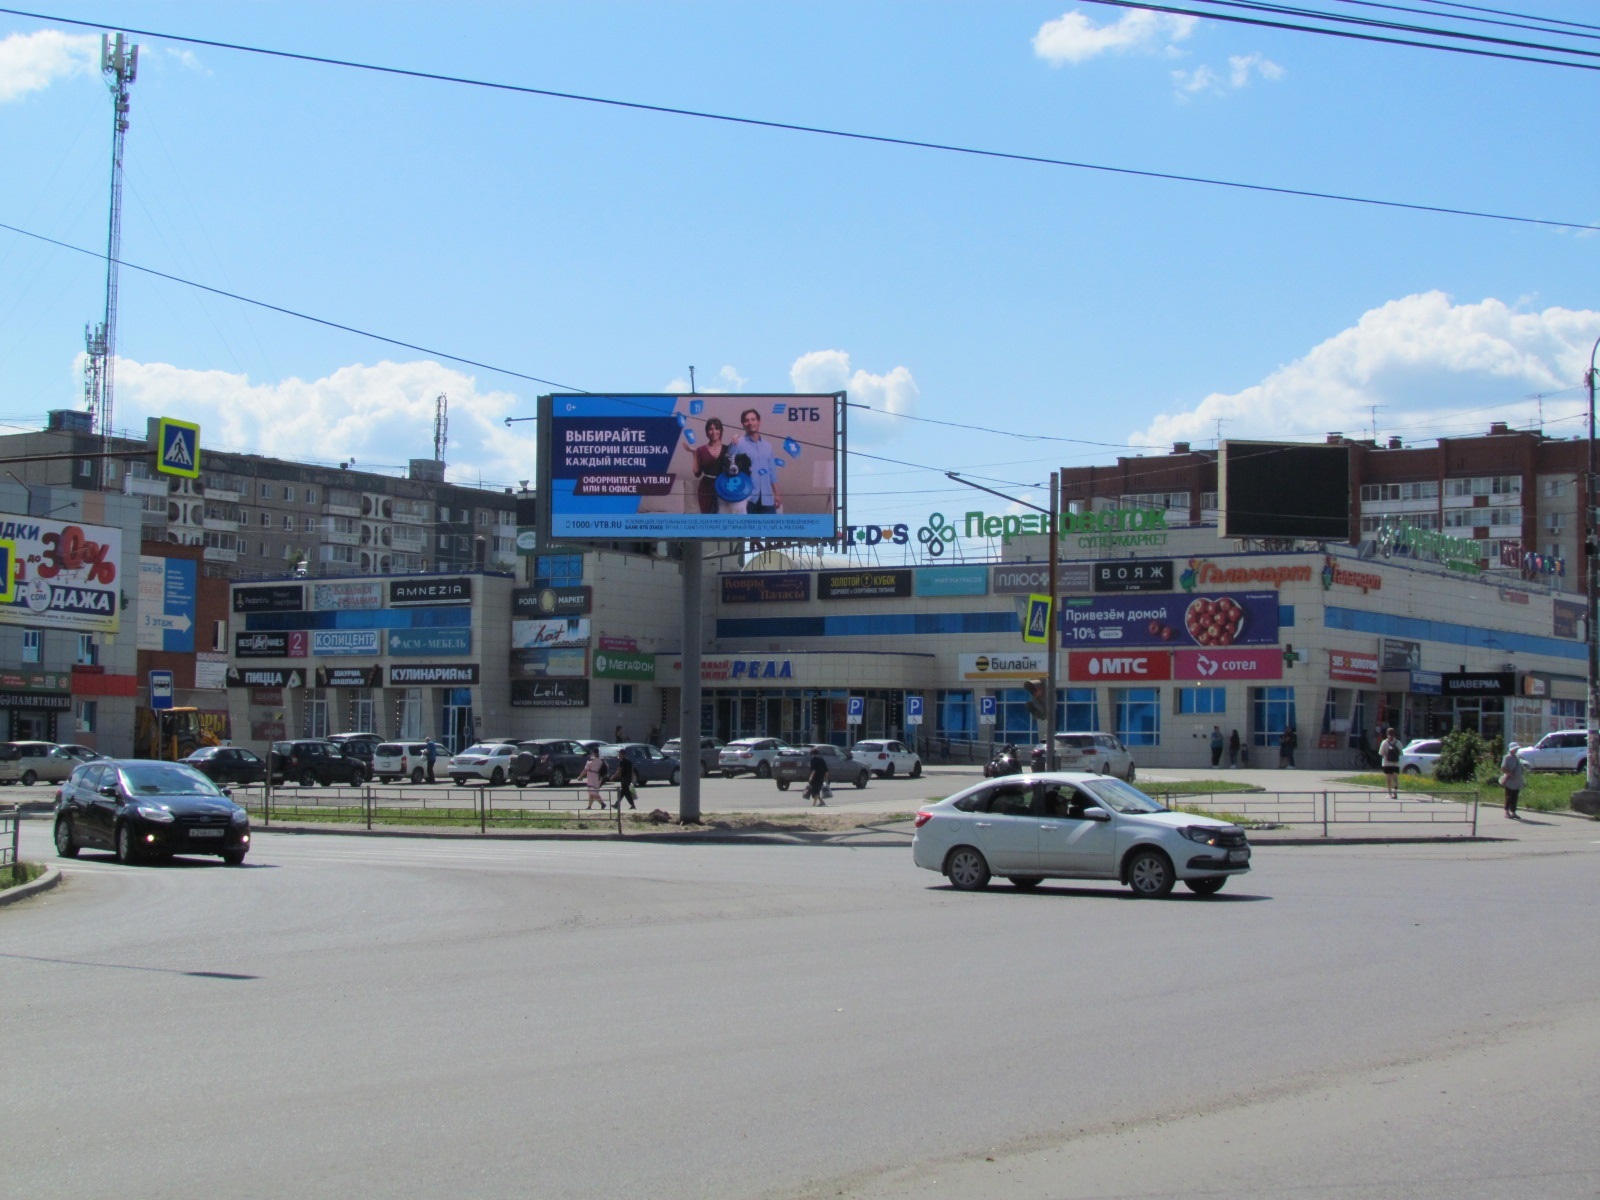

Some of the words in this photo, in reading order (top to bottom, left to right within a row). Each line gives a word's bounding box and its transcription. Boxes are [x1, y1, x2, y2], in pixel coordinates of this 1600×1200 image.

[788, 407, 820, 422] ВТБ
[565, 429, 646, 442] ВЫБИРАЙТЕ
[565, 445, 620, 455] КАТЕГОРИИ
[622, 445, 669, 455] КЕШБЭКА
[565, 456, 611, 467] КАЖДЫЙ
[613, 458, 646, 468] МЕСЯЦ
[583, 476, 627, 485] ОФОРМИТЕ
[629, 476, 641, 484] НА
[642, 475, 671, 484] VTB.RU
[583, 485, 599, 493] ИЛИ
[601, 485, 607, 493] В
[608, 485, 637, 494] ОФИСЕ
[572, 520, 590, 529] 1000
[594, 520, 622, 529] VTB.RU
[37, 526, 116, 584] 30%
[831, 576, 860, 587] ЗОЛОТОЙ
[874, 575, 896, 586] КУБОК
[1199, 563, 1312, 588] Галамарт
[724, 578, 764, 590] Ковры
[397, 586, 461, 596] AMNEZIA
[761, 590, 804, 600] Паласы
[558, 596, 584, 604] МАРКЕТ
[145, 615, 150, 626] 3
[1066, 609, 1124, 623] Привезём
[1127, 608, 1167, 622] домой
[294, 634, 302, 650] 2
[316, 633, 376, 648] КОПИЦЕНТР
[401, 640, 420, 648] АСМ
[428, 640, 466, 648] МЕБЕЛЬ
[731, 660, 792, 678] РЕАЛ
[1102, 658, 1148, 674] МТС
[244, 672, 283, 686] ПИЦЦА
[391, 668, 458, 680] КУЛИНАРИЯ
[534, 683, 564, 697] Leila
[1449, 679, 1500, 689] ШАВЕРМА
[11, 695, 70, 707] ПАМЯТНИКИ
